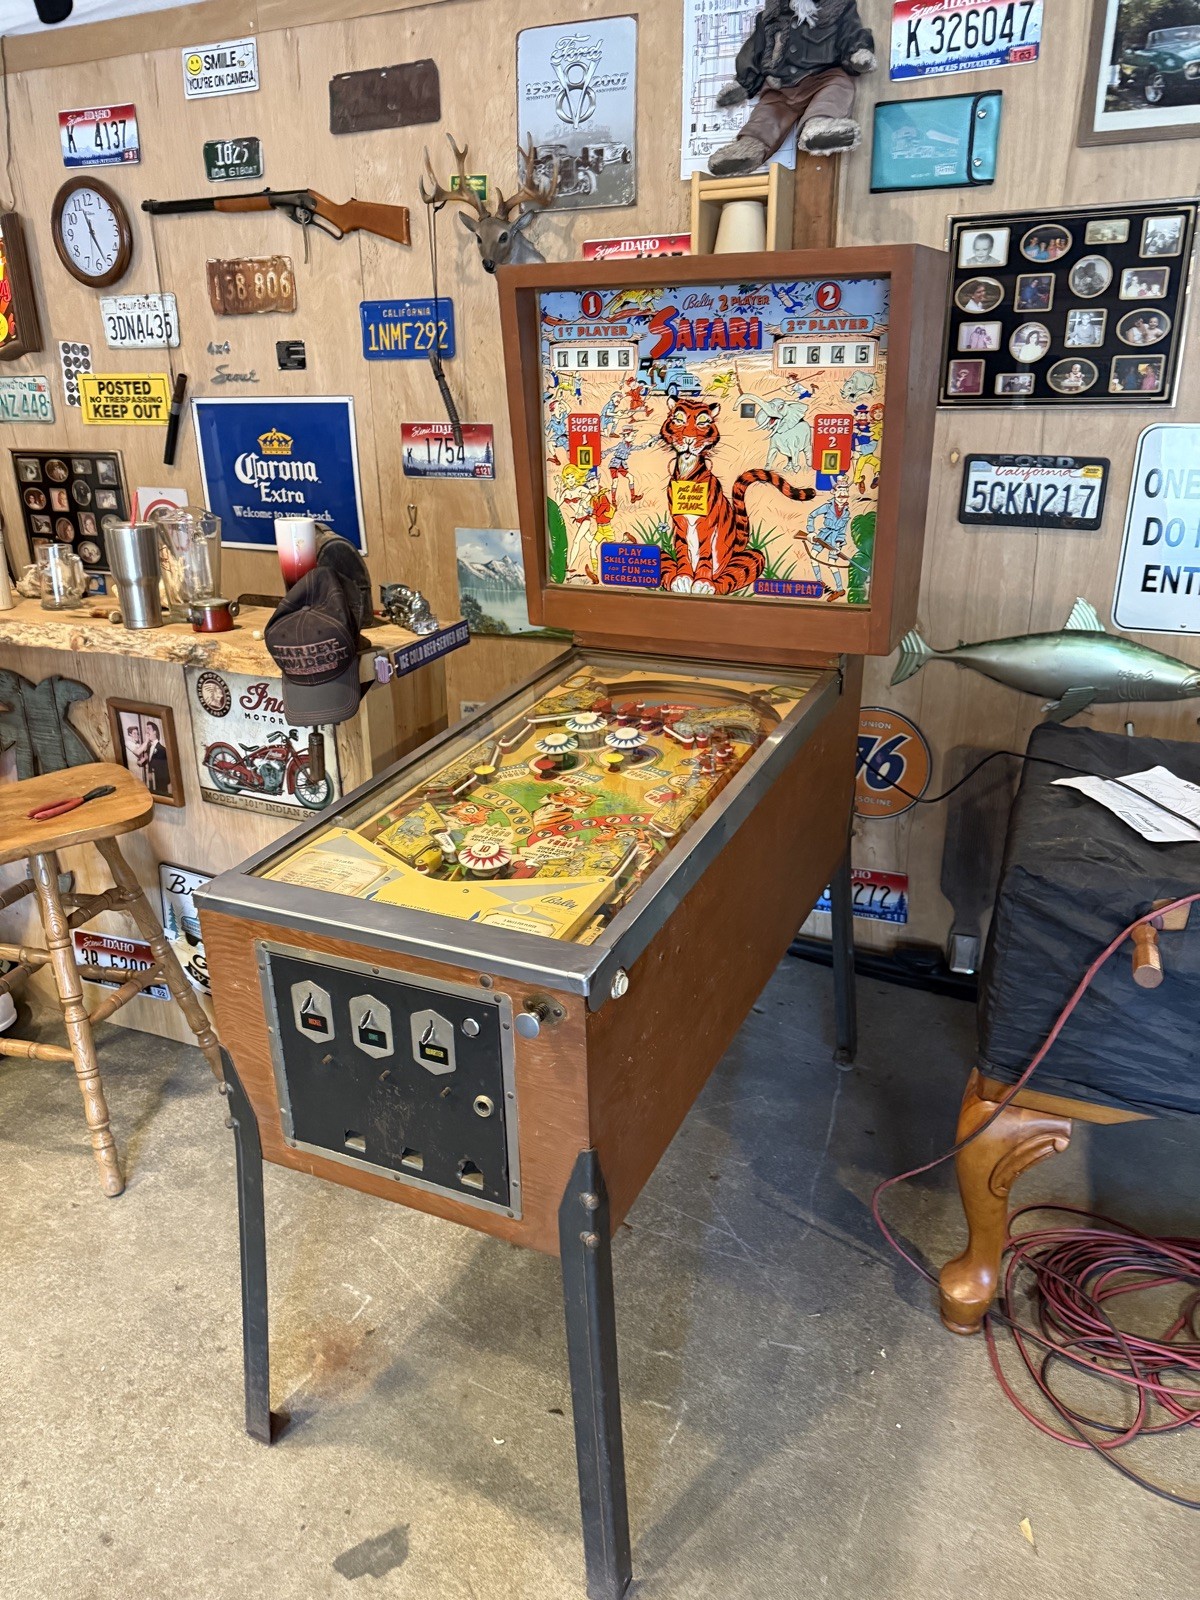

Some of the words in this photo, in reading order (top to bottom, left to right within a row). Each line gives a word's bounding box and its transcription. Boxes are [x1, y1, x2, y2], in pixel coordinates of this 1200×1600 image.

[906, 19, 922, 58] K
[930, 2, 1034, 54] 326047
[551, 33, 603, 62] Ford
[204, 51, 237, 71] SMILE
[188, 76, 213, 90] YOU'RE
[215, 76, 226, 87] ON
[226, 70, 256, 86] CAMERA
[66, 124, 77, 153] K
[95, 120, 126, 151] 4137
[73, 199, 82, 212] 11
[83, 193, 93, 207] 12
[97, 197, 102, 210] 1
[68, 212, 78, 226] 10
[107, 209, 114, 221] 2
[67, 228, 74, 241] 9
[112, 224, 119, 237] 3
[73, 244, 81, 257] 8
[620, 239, 659, 253] IDAHO
[84, 256, 90, 269] 7
[96, 259, 103, 271] 6
[106, 254, 113, 266] 5
[682, 293, 715, 310] Bally
[718, 295, 728, 312] 2
[731, 295, 770, 306] PLAYER
[823, 285, 836, 307] 2
[383, 307, 431, 317] CALIFORNIA
[588, 296, 597, 315] 1
[577, 326, 629, 337] PLAYER
[648, 305, 762, 359] SAFARI
[808, 319, 868, 331] PLAYER
[369, 322, 449, 350] 1NMF292
[97, 381, 151, 395] POSTED
[22, 393, 48, 417] 448
[94, 404, 128, 418] KEEP
[133, 404, 160, 418] OUT
[571, 417, 598, 425] SUPER
[817, 418, 850, 427] SUPER
[571, 425, 599, 433] SCORE
[817, 427, 850, 435] SCORE
[582, 434, 588, 445] 1
[829, 437, 837, 448] 2
[407, 447, 413, 464] K
[425, 438, 466, 464] 1754
[234, 452, 319, 488] Corona
[995, 466, 1071, 481] California
[1144, 468, 1200, 499] ONE
[260, 482, 305, 503] Extra
[972, 481, 1096, 517] 5CKN217
[233, 506, 273, 519] Welcome
[677, 503, 704, 511] TANK
[1143, 517, 1186, 548] DO
[618, 547, 642, 556] PLAY
[604, 556, 626, 564] SKILL
[628, 558, 657, 566] GAMES
[621, 566, 640, 574] FUN
[604, 574, 658, 584] RECREATION
[757, 581, 779, 594] BALL
[782, 583, 792, 594] IN
[795, 584, 818, 596] PLAY
[861, 720, 891, 729] UNION
[205, 790, 237, 804] MODEL
[266, 804, 300, 816] INDIAN
[541, 895, 579, 909] Bally
[102, 939, 134, 953] IDAHO
